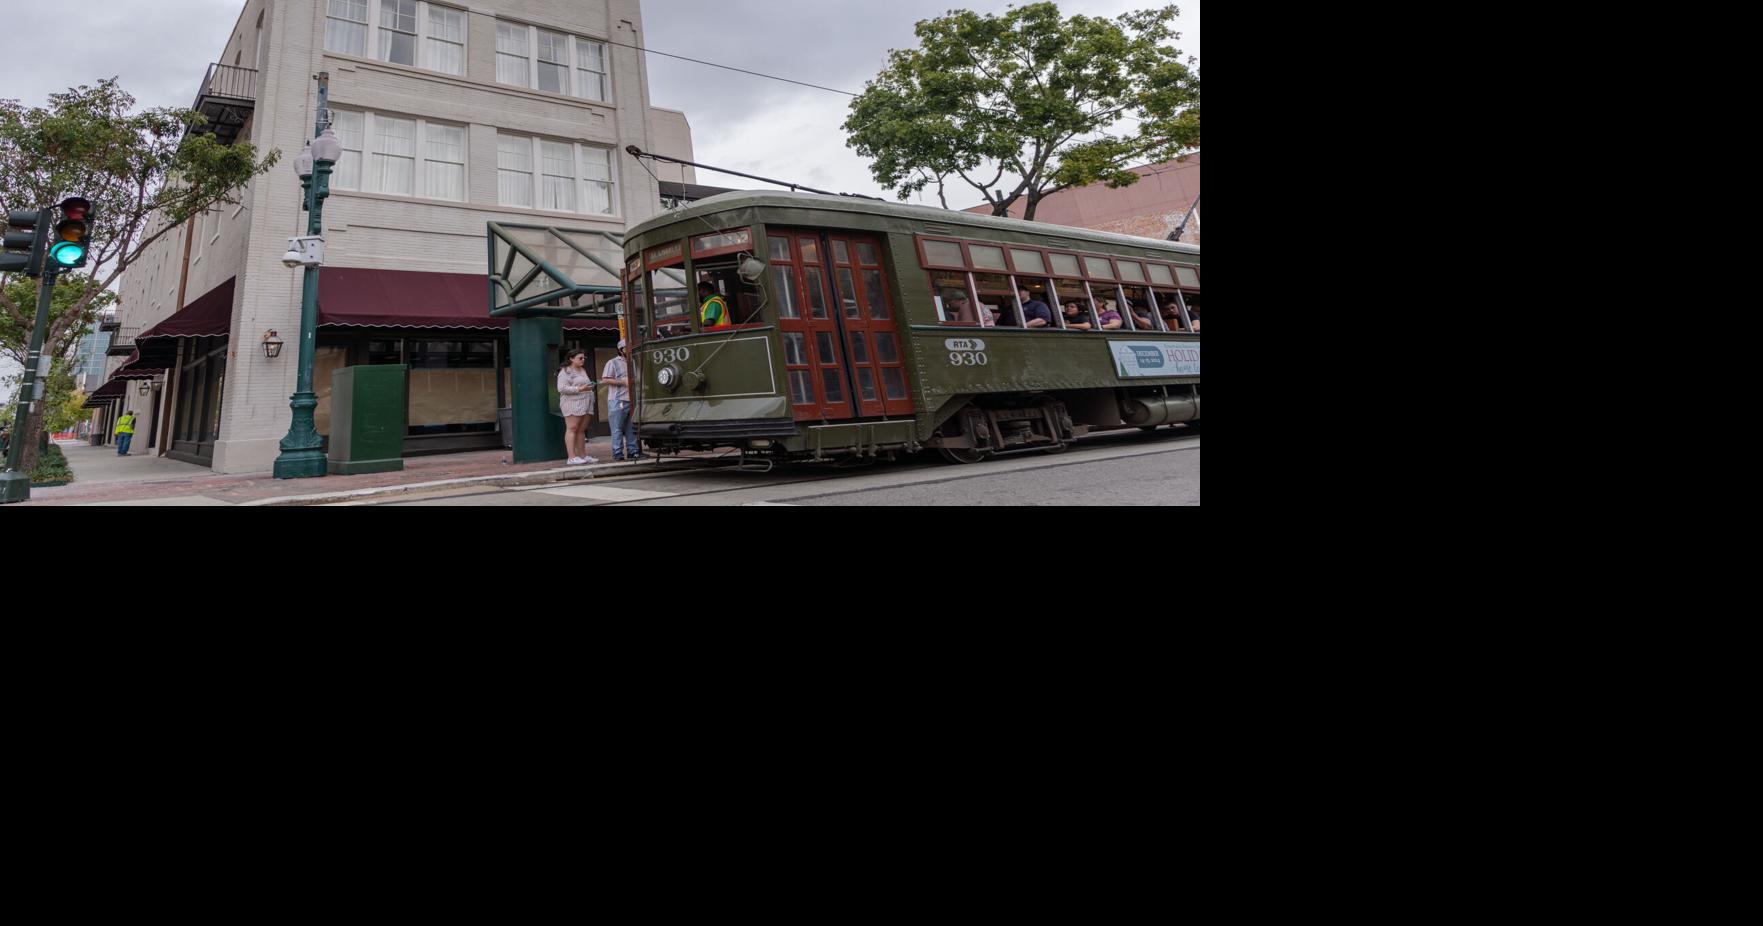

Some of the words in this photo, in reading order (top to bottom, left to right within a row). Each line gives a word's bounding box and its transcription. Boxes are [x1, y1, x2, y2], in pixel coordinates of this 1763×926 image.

[953, 341, 969, 349] RTA
[653, 347, 690, 364] 930
[949, 352, 988, 366] 930
